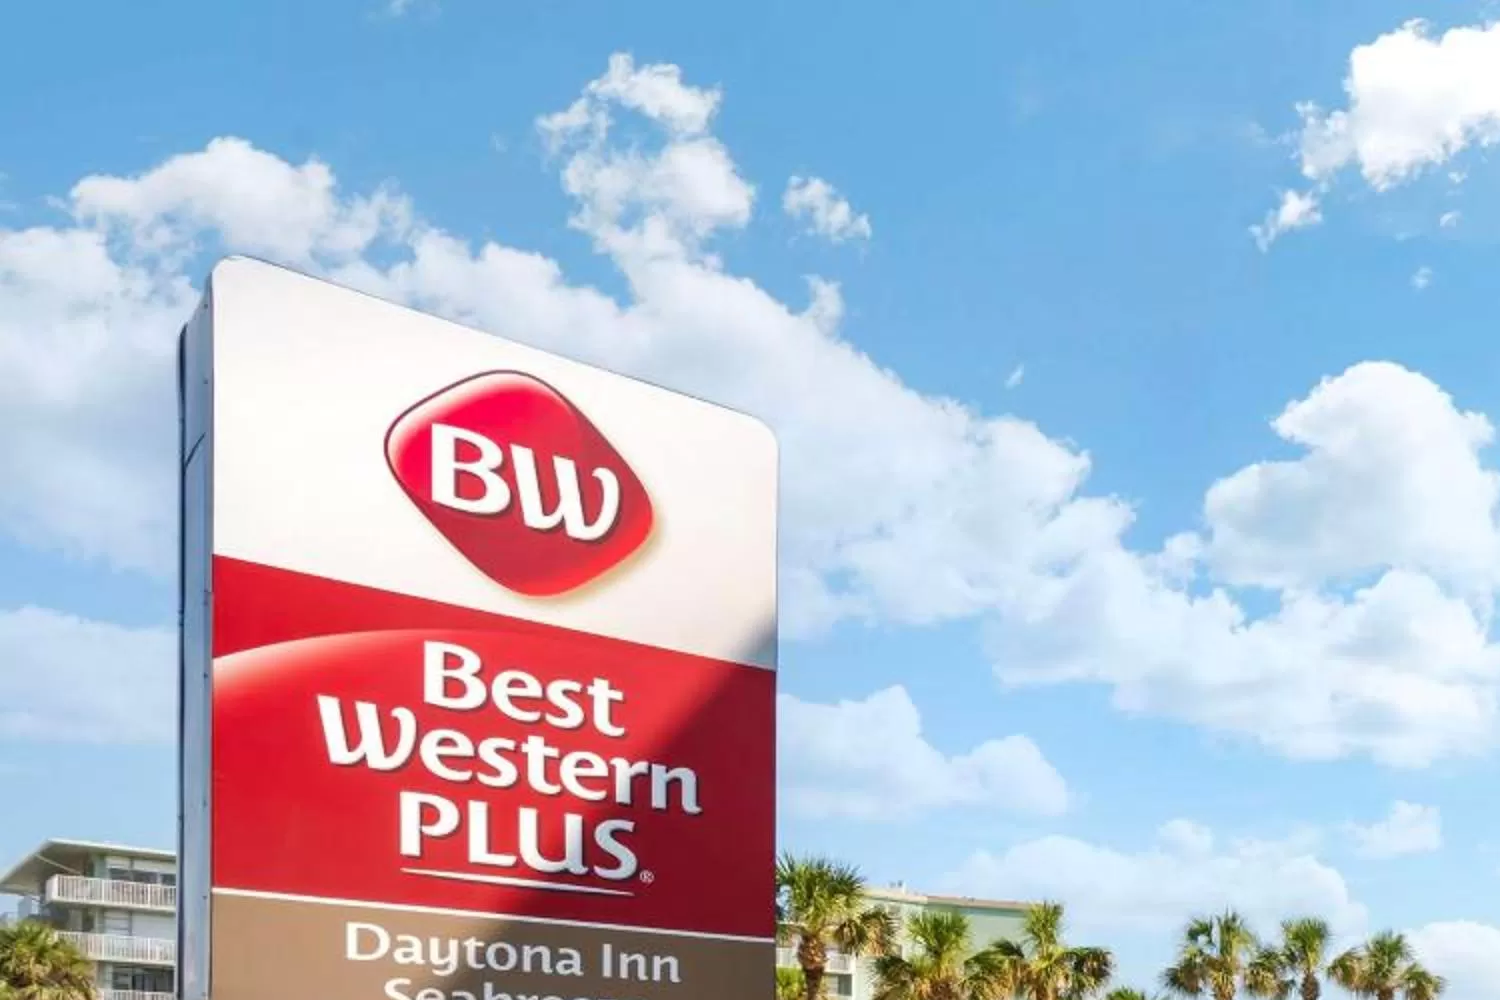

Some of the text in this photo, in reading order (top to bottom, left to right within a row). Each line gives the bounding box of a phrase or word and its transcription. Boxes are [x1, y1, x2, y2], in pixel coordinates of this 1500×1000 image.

[431, 423, 621, 542] BW
[423, 640, 626, 737] Best
[317, 694, 702, 815] Western
[345, 921, 682, 984] Daytona Inn
